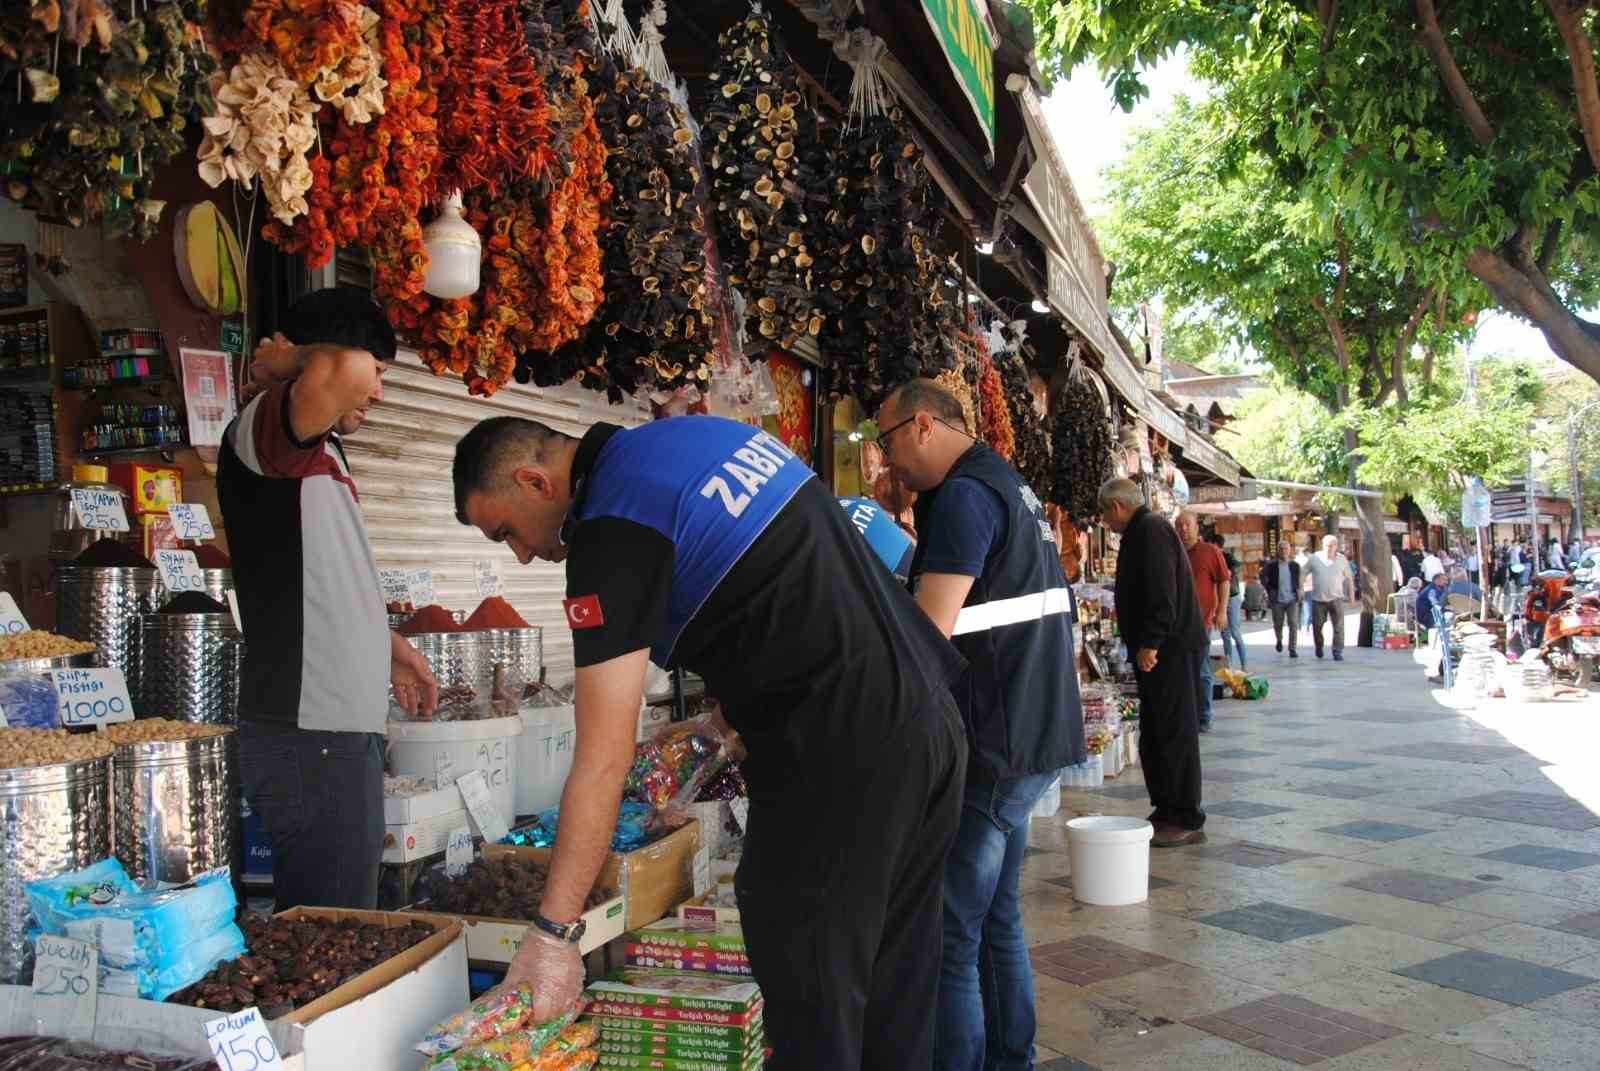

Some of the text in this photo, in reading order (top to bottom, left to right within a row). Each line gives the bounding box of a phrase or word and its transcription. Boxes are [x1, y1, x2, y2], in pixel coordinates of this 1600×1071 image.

[83, 512, 121, 529] 250
[183, 520, 211, 537] 250
[851, 503, 878, 535] ITA
[168, 575, 201, 590] 200
[62, 697, 124, 723] 1000
[33, 963, 90, 995] 250
[214, 1033, 276, 1071] 150
